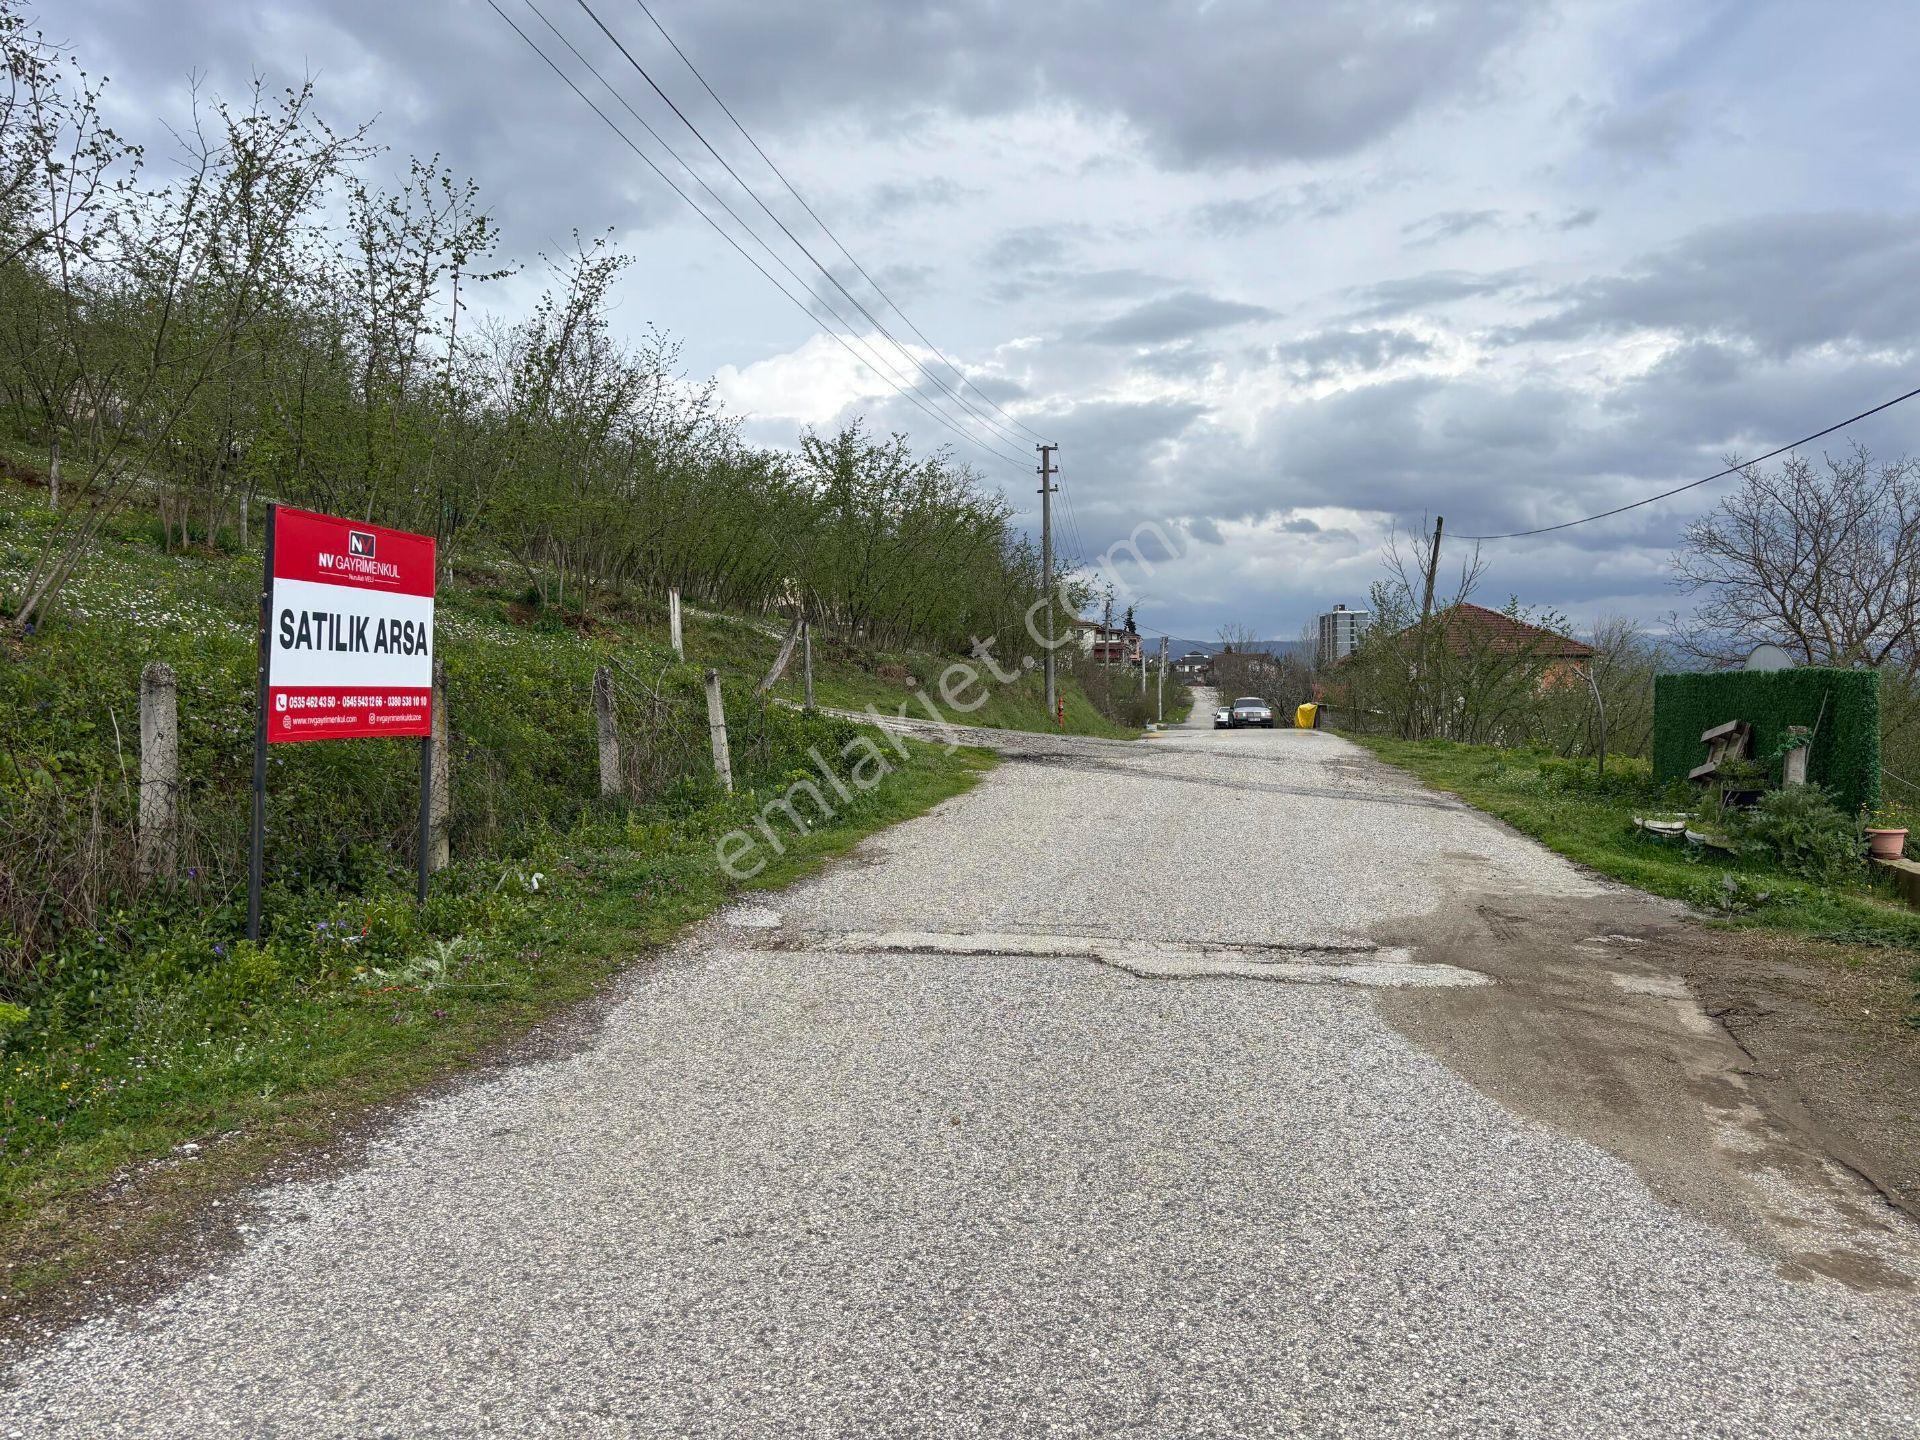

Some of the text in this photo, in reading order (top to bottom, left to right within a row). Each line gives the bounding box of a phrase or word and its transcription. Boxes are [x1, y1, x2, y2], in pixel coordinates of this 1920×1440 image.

[318, 552, 401, 579] NV GAYRİMENKUL
[279, 608, 428, 657] SATILIK ARSA
[289, 695, 306, 709] 0535
